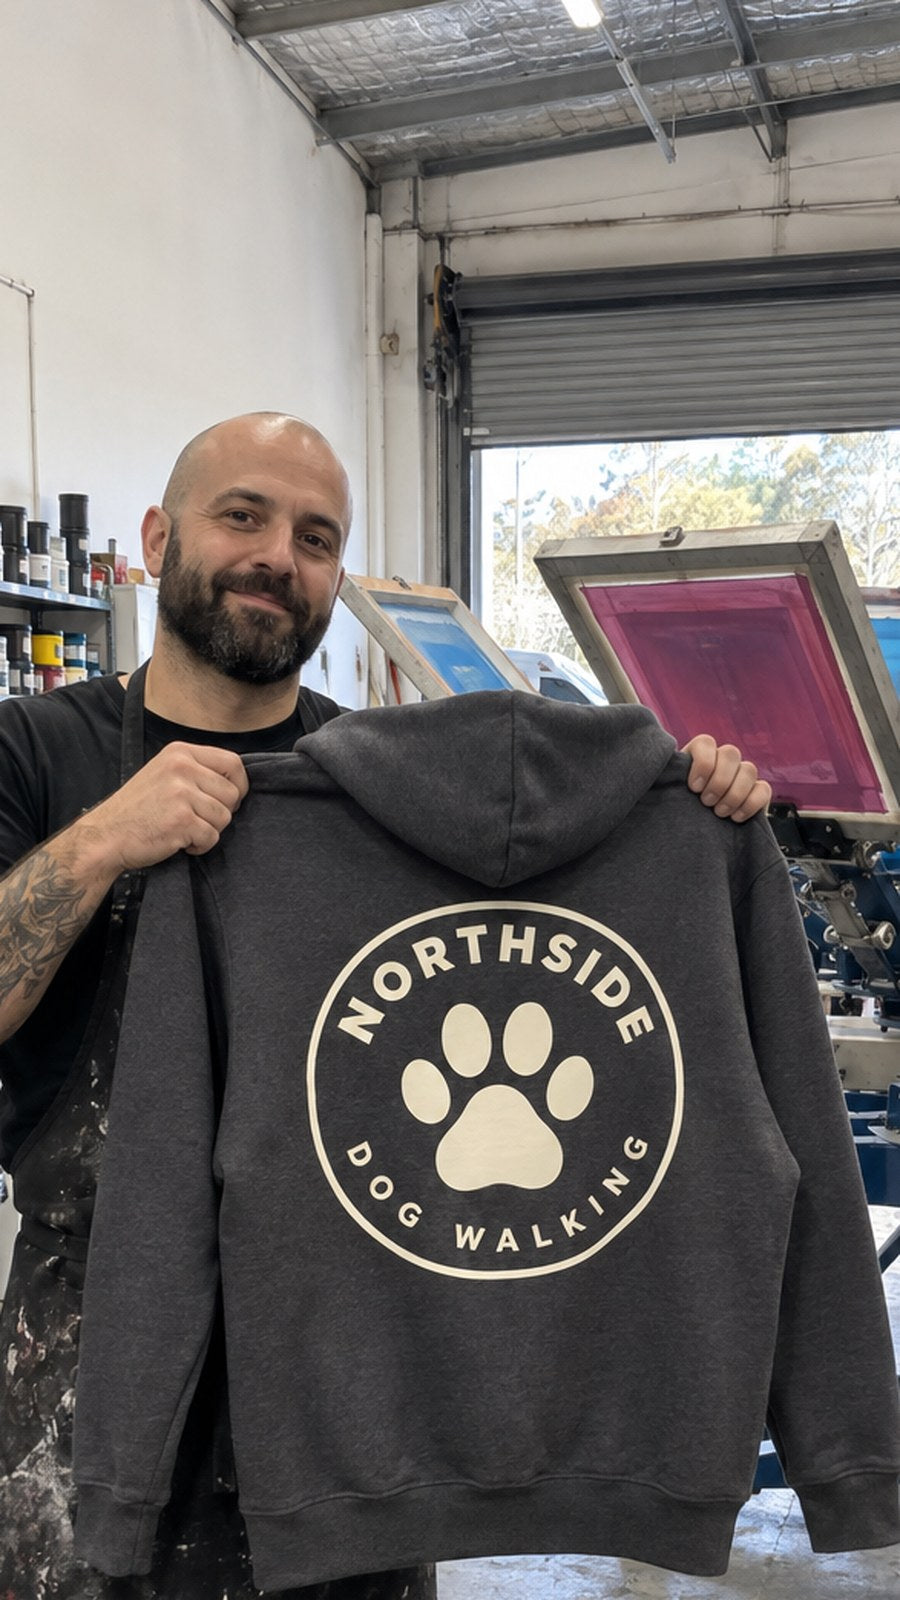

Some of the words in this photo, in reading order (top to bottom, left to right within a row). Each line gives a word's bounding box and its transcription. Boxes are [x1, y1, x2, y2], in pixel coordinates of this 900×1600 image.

[338, 924, 654, 1044] NORTHSIDE
[347, 1141, 422, 1227] DOG
[456, 1136, 648, 1252] WALKING
